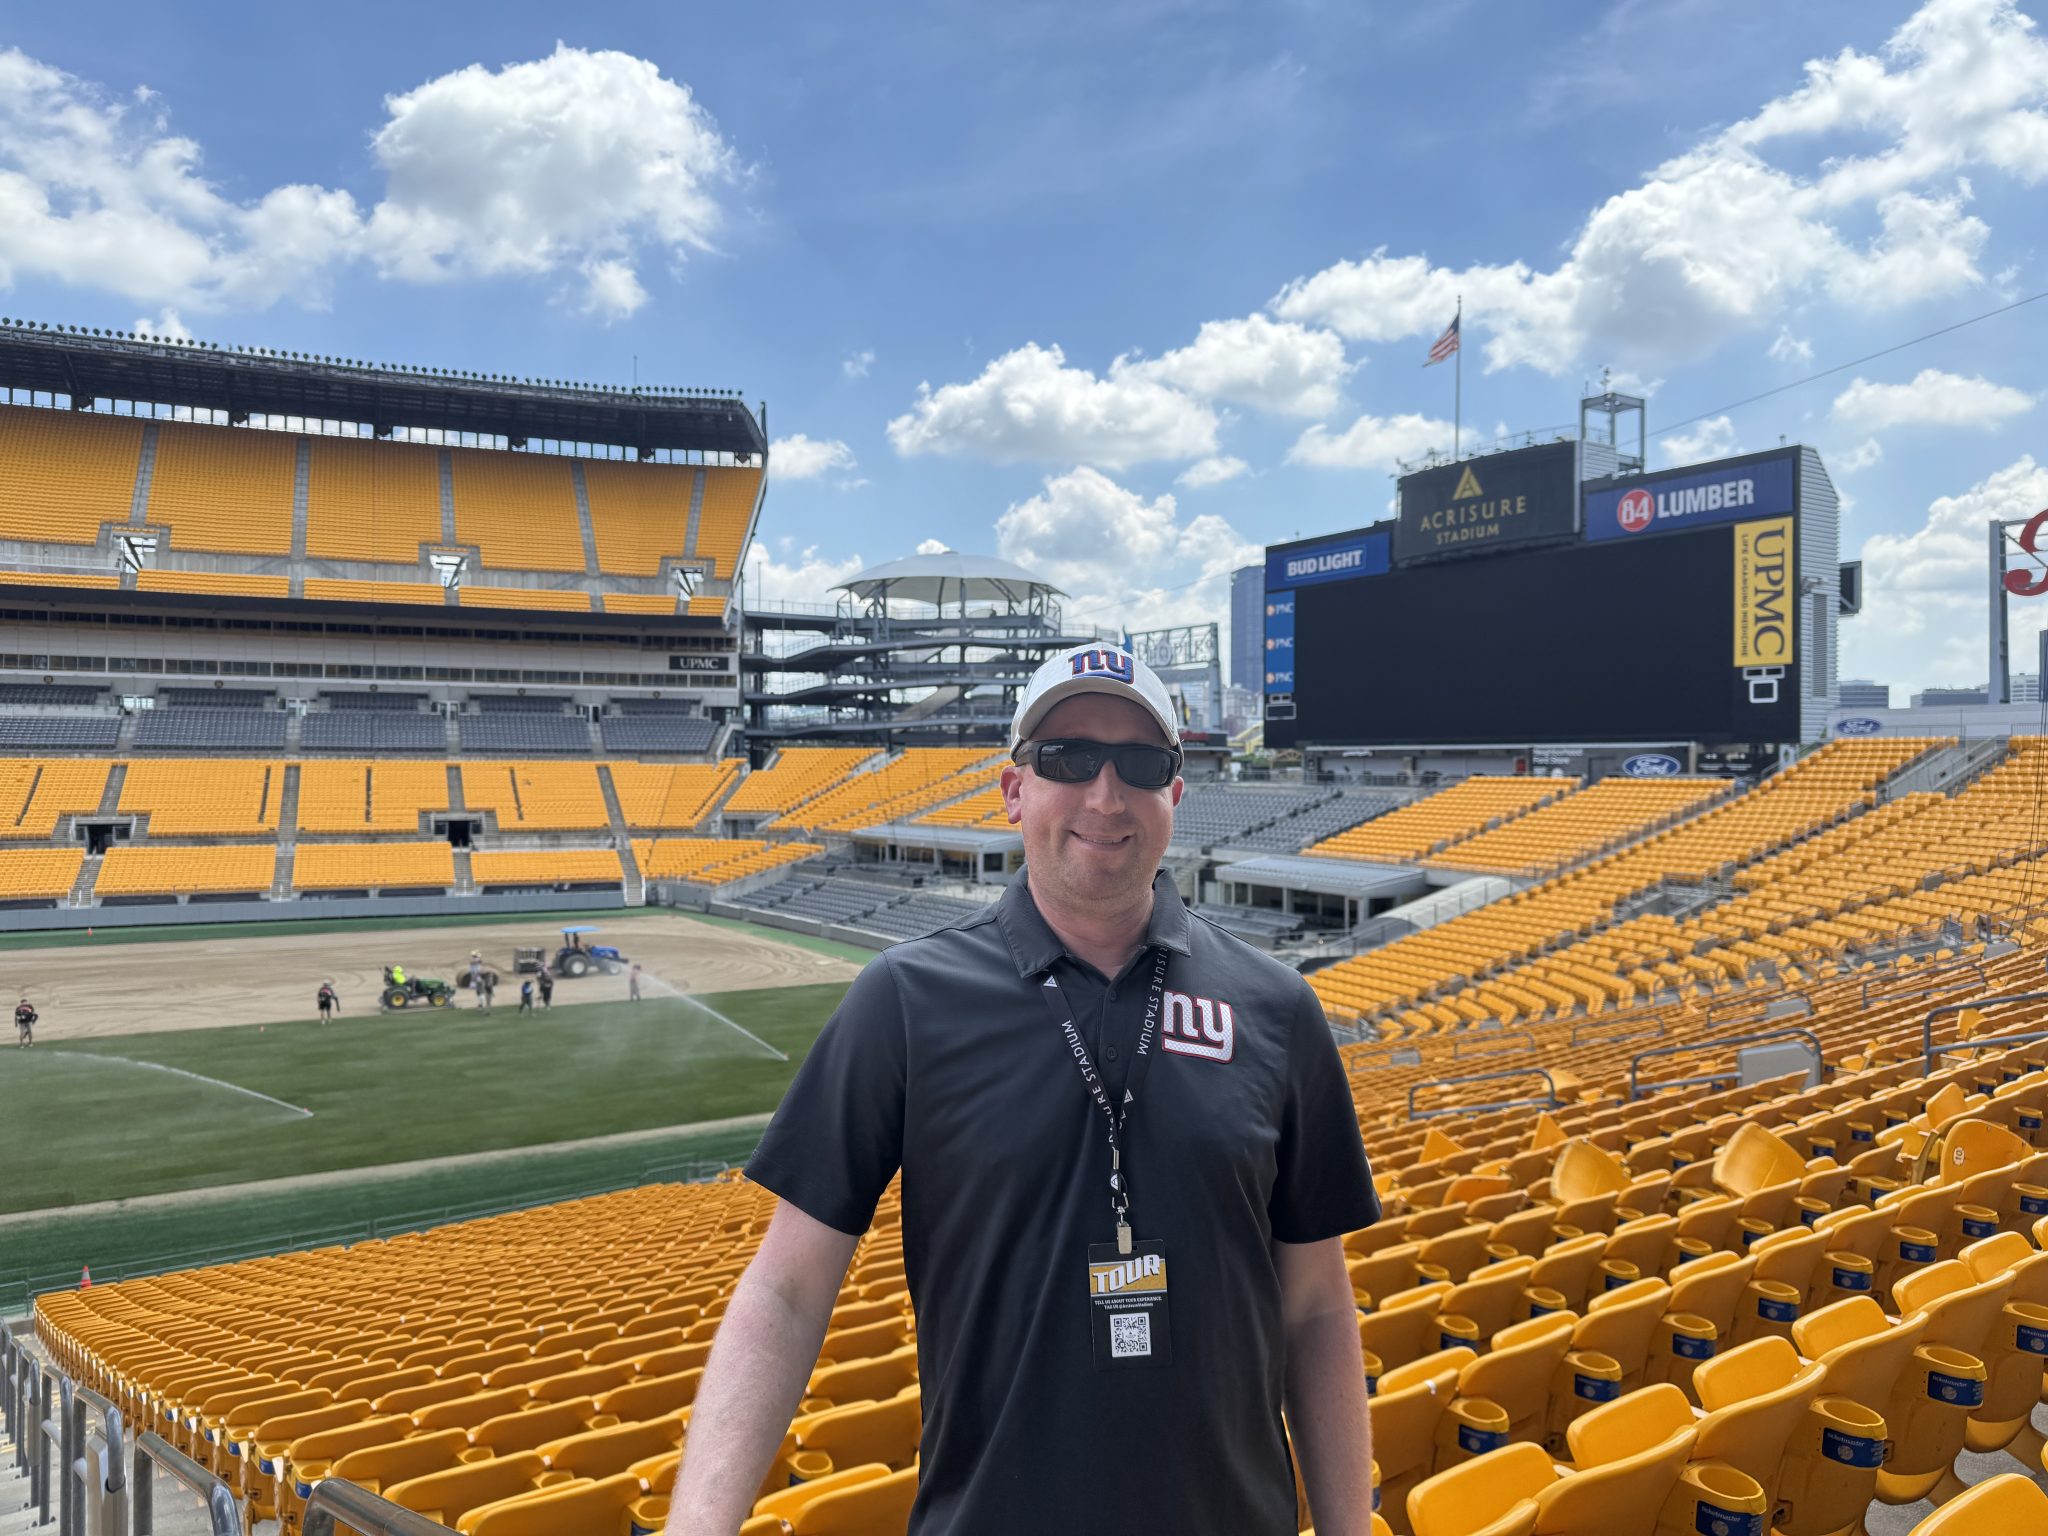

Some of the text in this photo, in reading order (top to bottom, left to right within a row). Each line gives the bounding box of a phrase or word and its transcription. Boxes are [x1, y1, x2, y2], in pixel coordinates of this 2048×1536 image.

[1420, 496, 1527, 532] ACRISURE
[1621, 478, 1755, 525] 84 LUMBER
[1436, 523, 1499, 545] STADIUM
[1287, 550, 1364, 578] BUD LIGHT
[1754, 525, 1785, 657] UPMC
[1275, 602, 1294, 615] PNC
[1275, 637, 1294, 649] PNC
[680, 658, 720, 669] UPMC
[1274, 671, 1293, 683] PNC
[1137, 996, 1159, 1055] STADIUM
[1062, 1020, 1097, 1082] STADIUM
[1955, 1149, 1963, 1161] 10
[1092, 1254, 1160, 1293] TOUR
